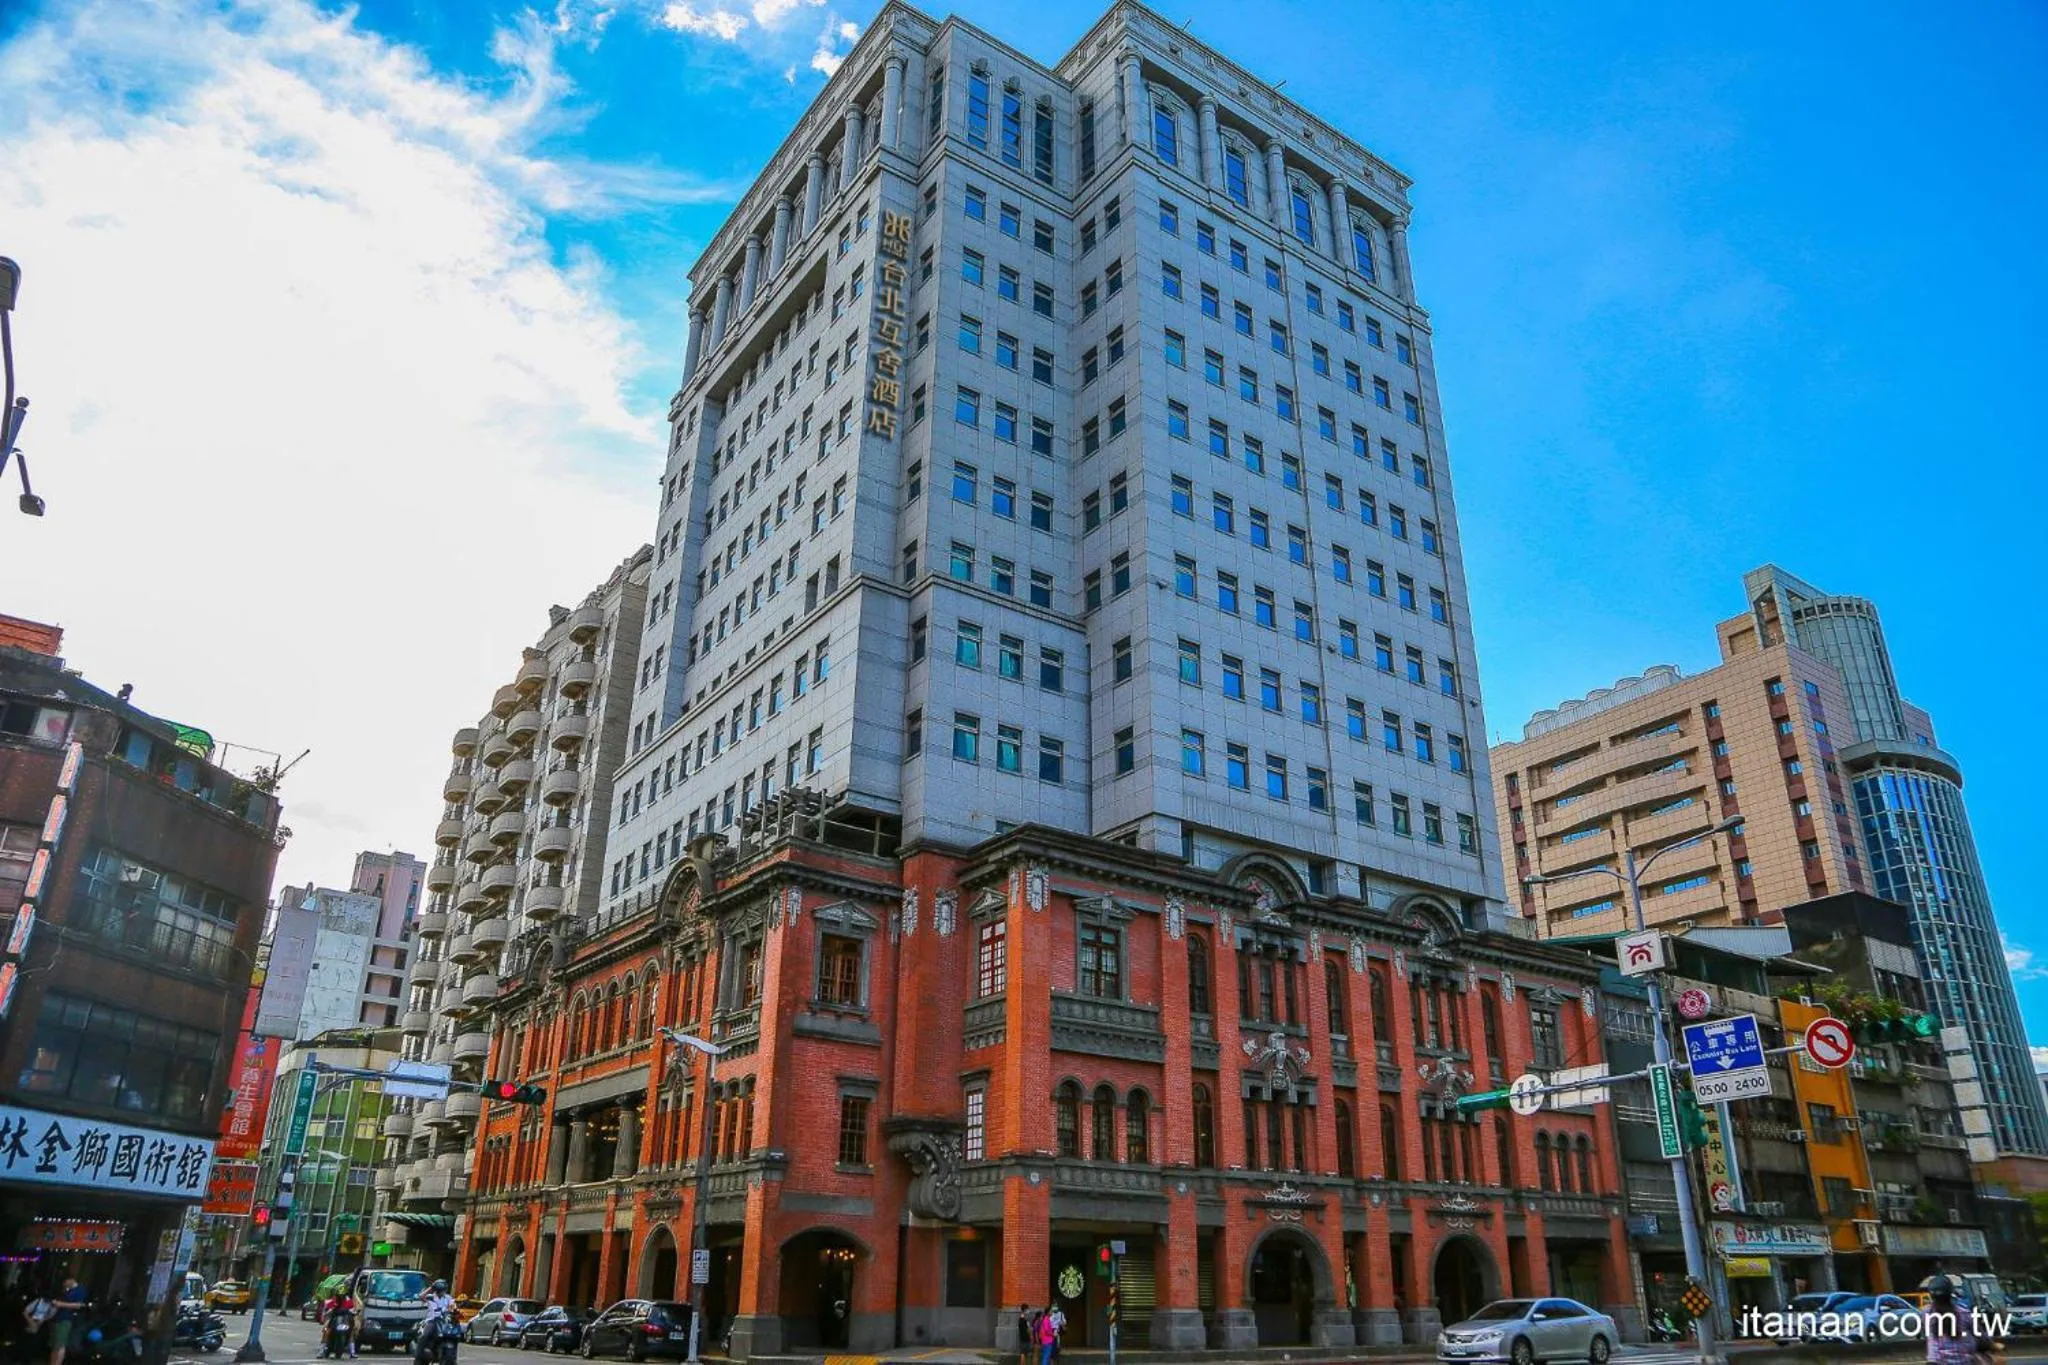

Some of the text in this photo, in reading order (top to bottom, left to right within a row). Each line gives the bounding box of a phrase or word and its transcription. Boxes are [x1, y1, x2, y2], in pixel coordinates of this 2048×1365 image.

[869, 260, 908, 441] 台北互舍酒店
[1690, 1030, 1756, 1053] 公車專用
